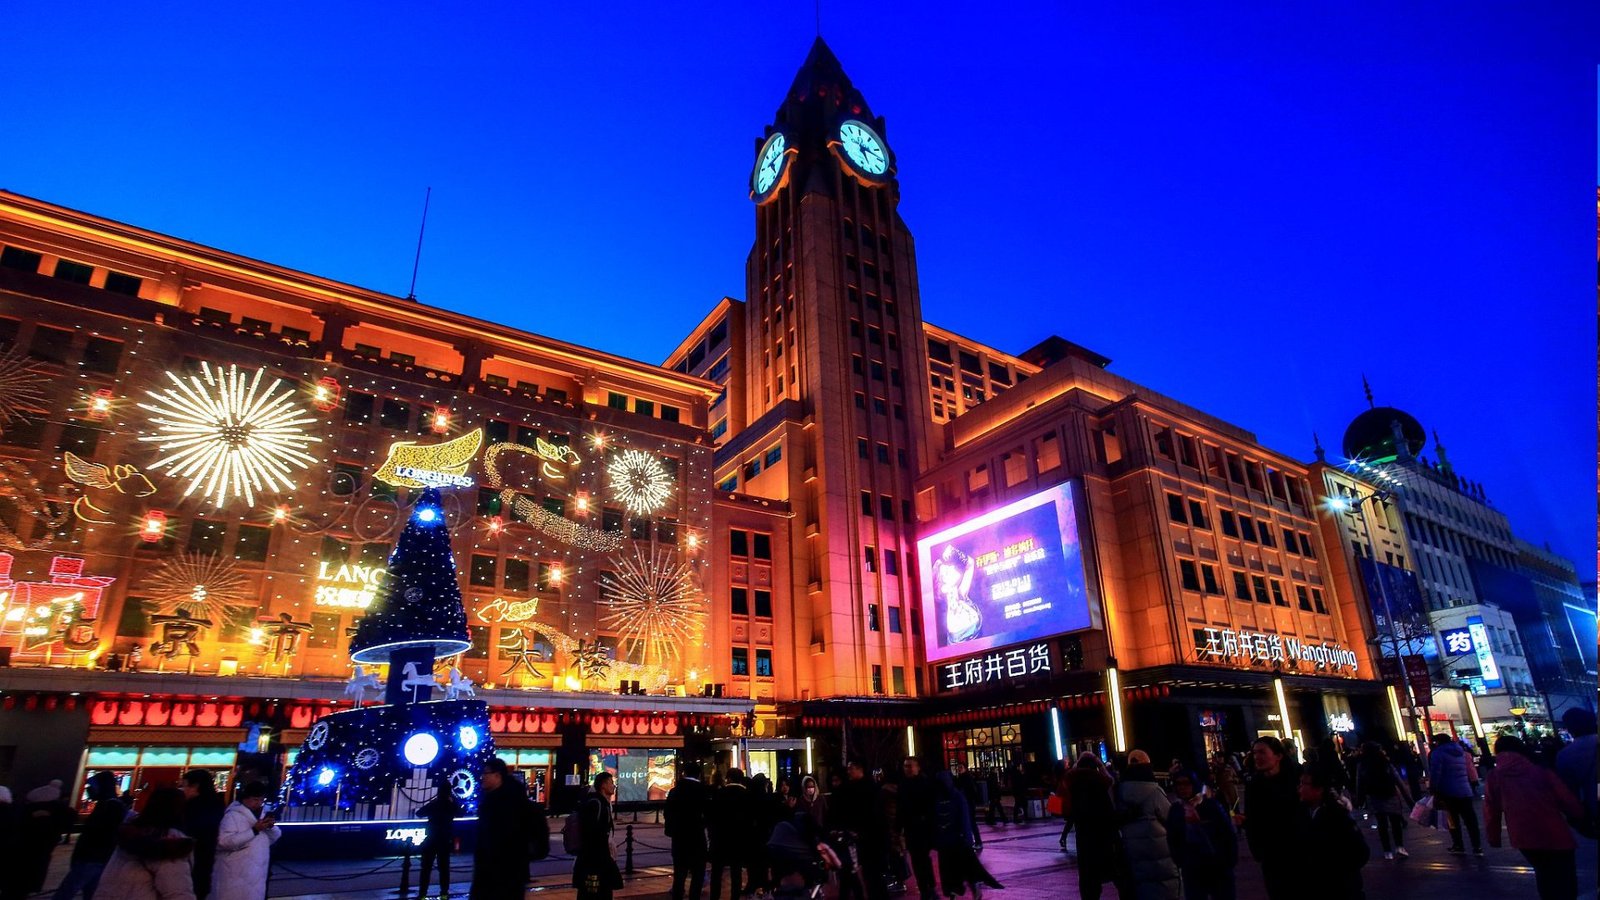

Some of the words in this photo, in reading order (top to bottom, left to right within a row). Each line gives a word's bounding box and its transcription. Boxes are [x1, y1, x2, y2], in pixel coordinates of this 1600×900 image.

[395, 466, 474, 487] LONGINES
[1203, 627, 1284, 662] 王府井百货
[1285, 637, 1358, 671] Wangfujing
[1445, 631, 1471, 653] 药
[945, 643, 1051, 689] 王府井百货
